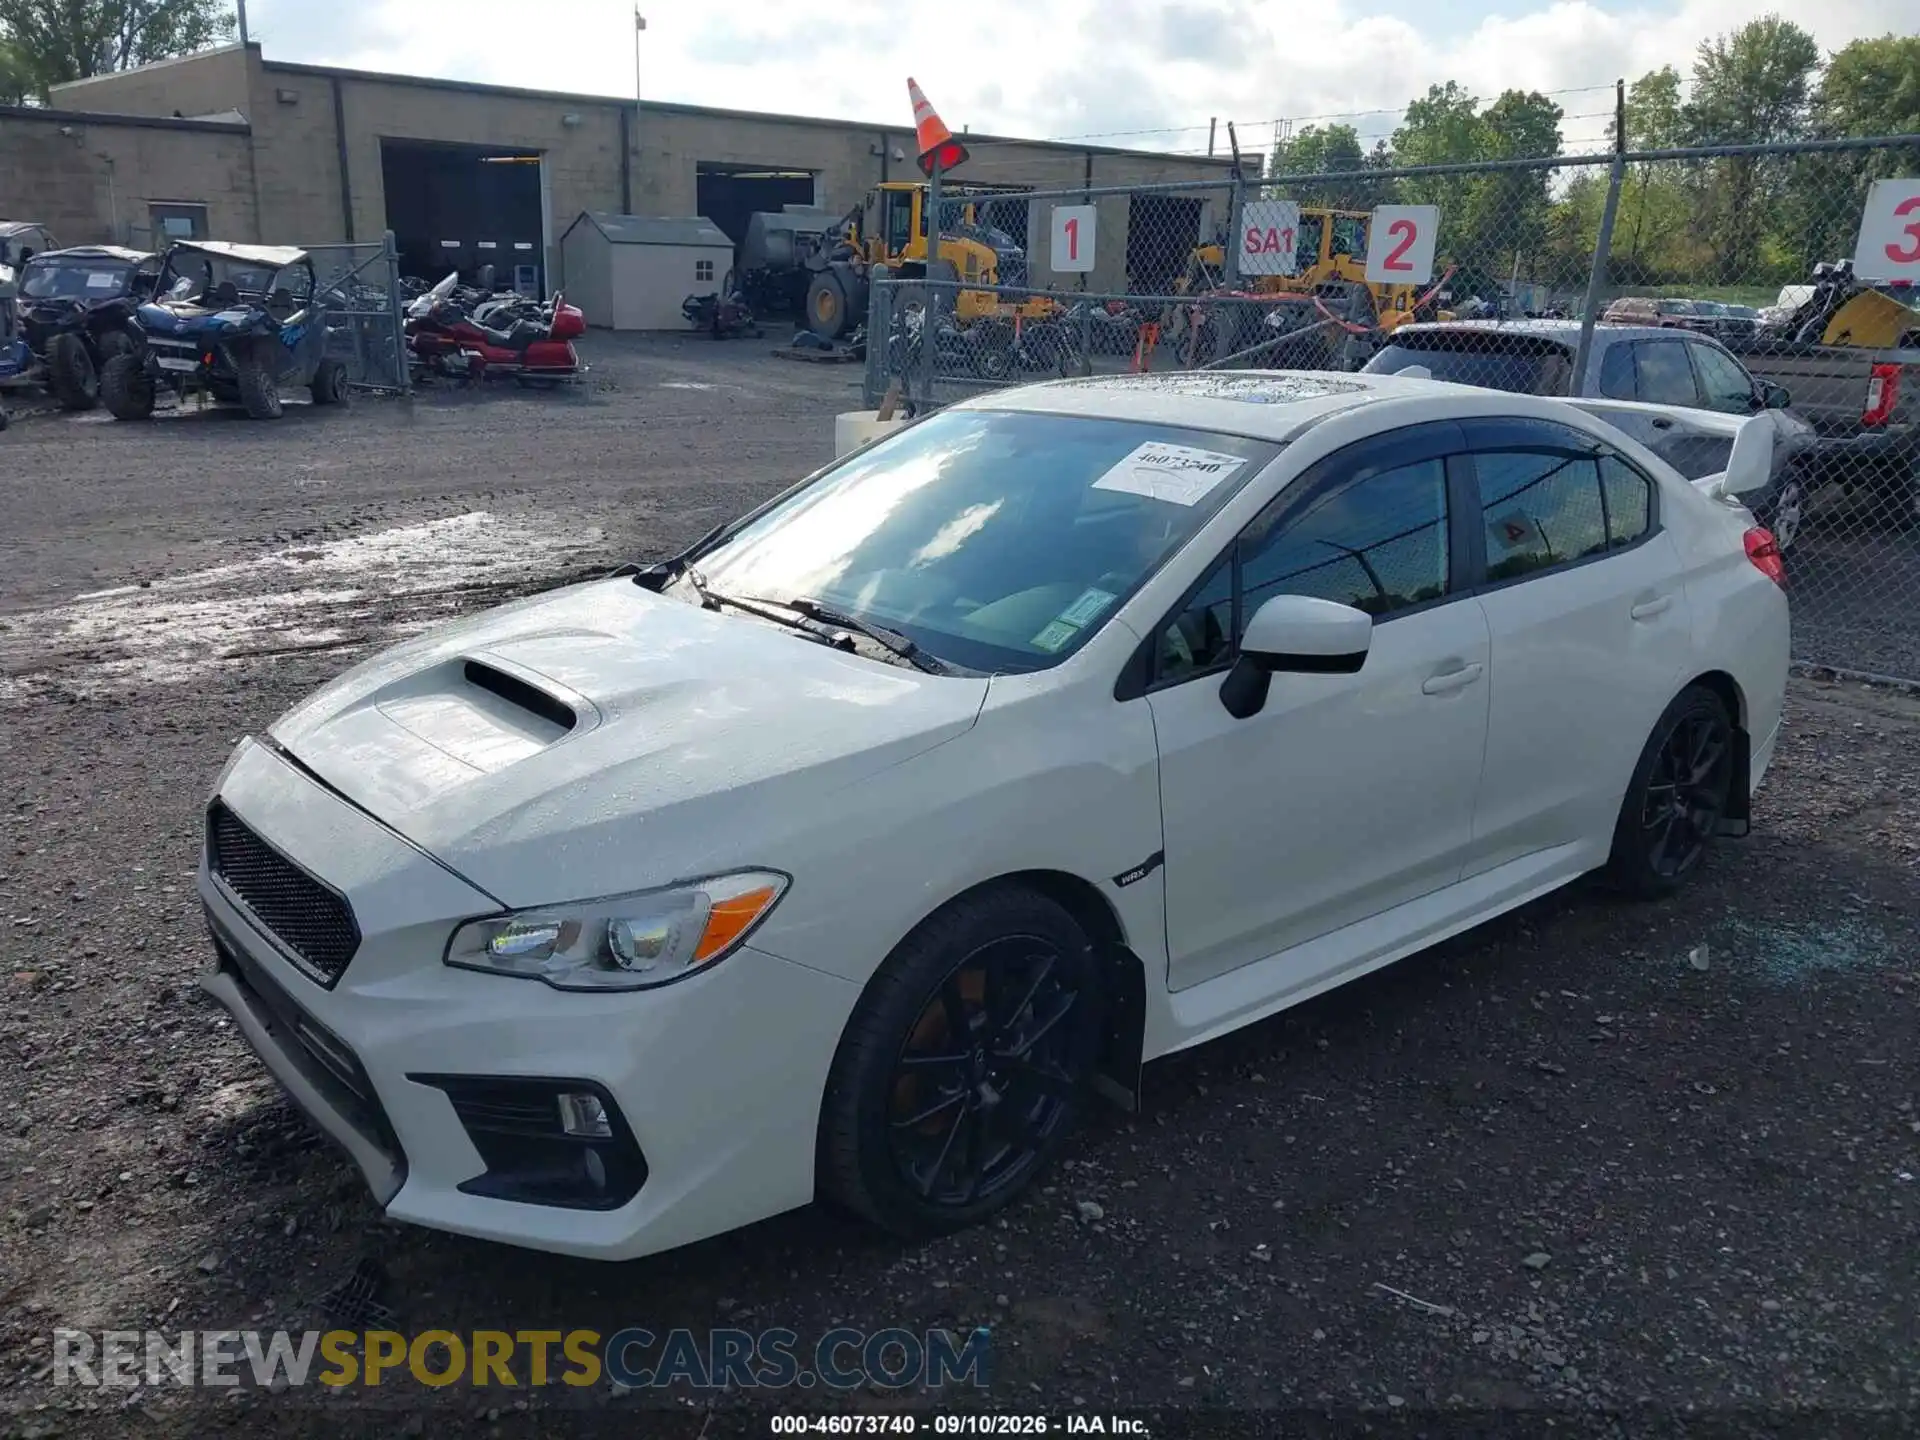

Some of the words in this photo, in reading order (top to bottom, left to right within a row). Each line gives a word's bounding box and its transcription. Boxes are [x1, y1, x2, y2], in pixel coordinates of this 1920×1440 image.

[1064, 218, 1079, 261] 1
[1245, 227, 1294, 254] SA1
[1383, 219, 1417, 271] 2
[1885, 197, 1920, 262] 3
[1121, 867, 1145, 885] WRX
